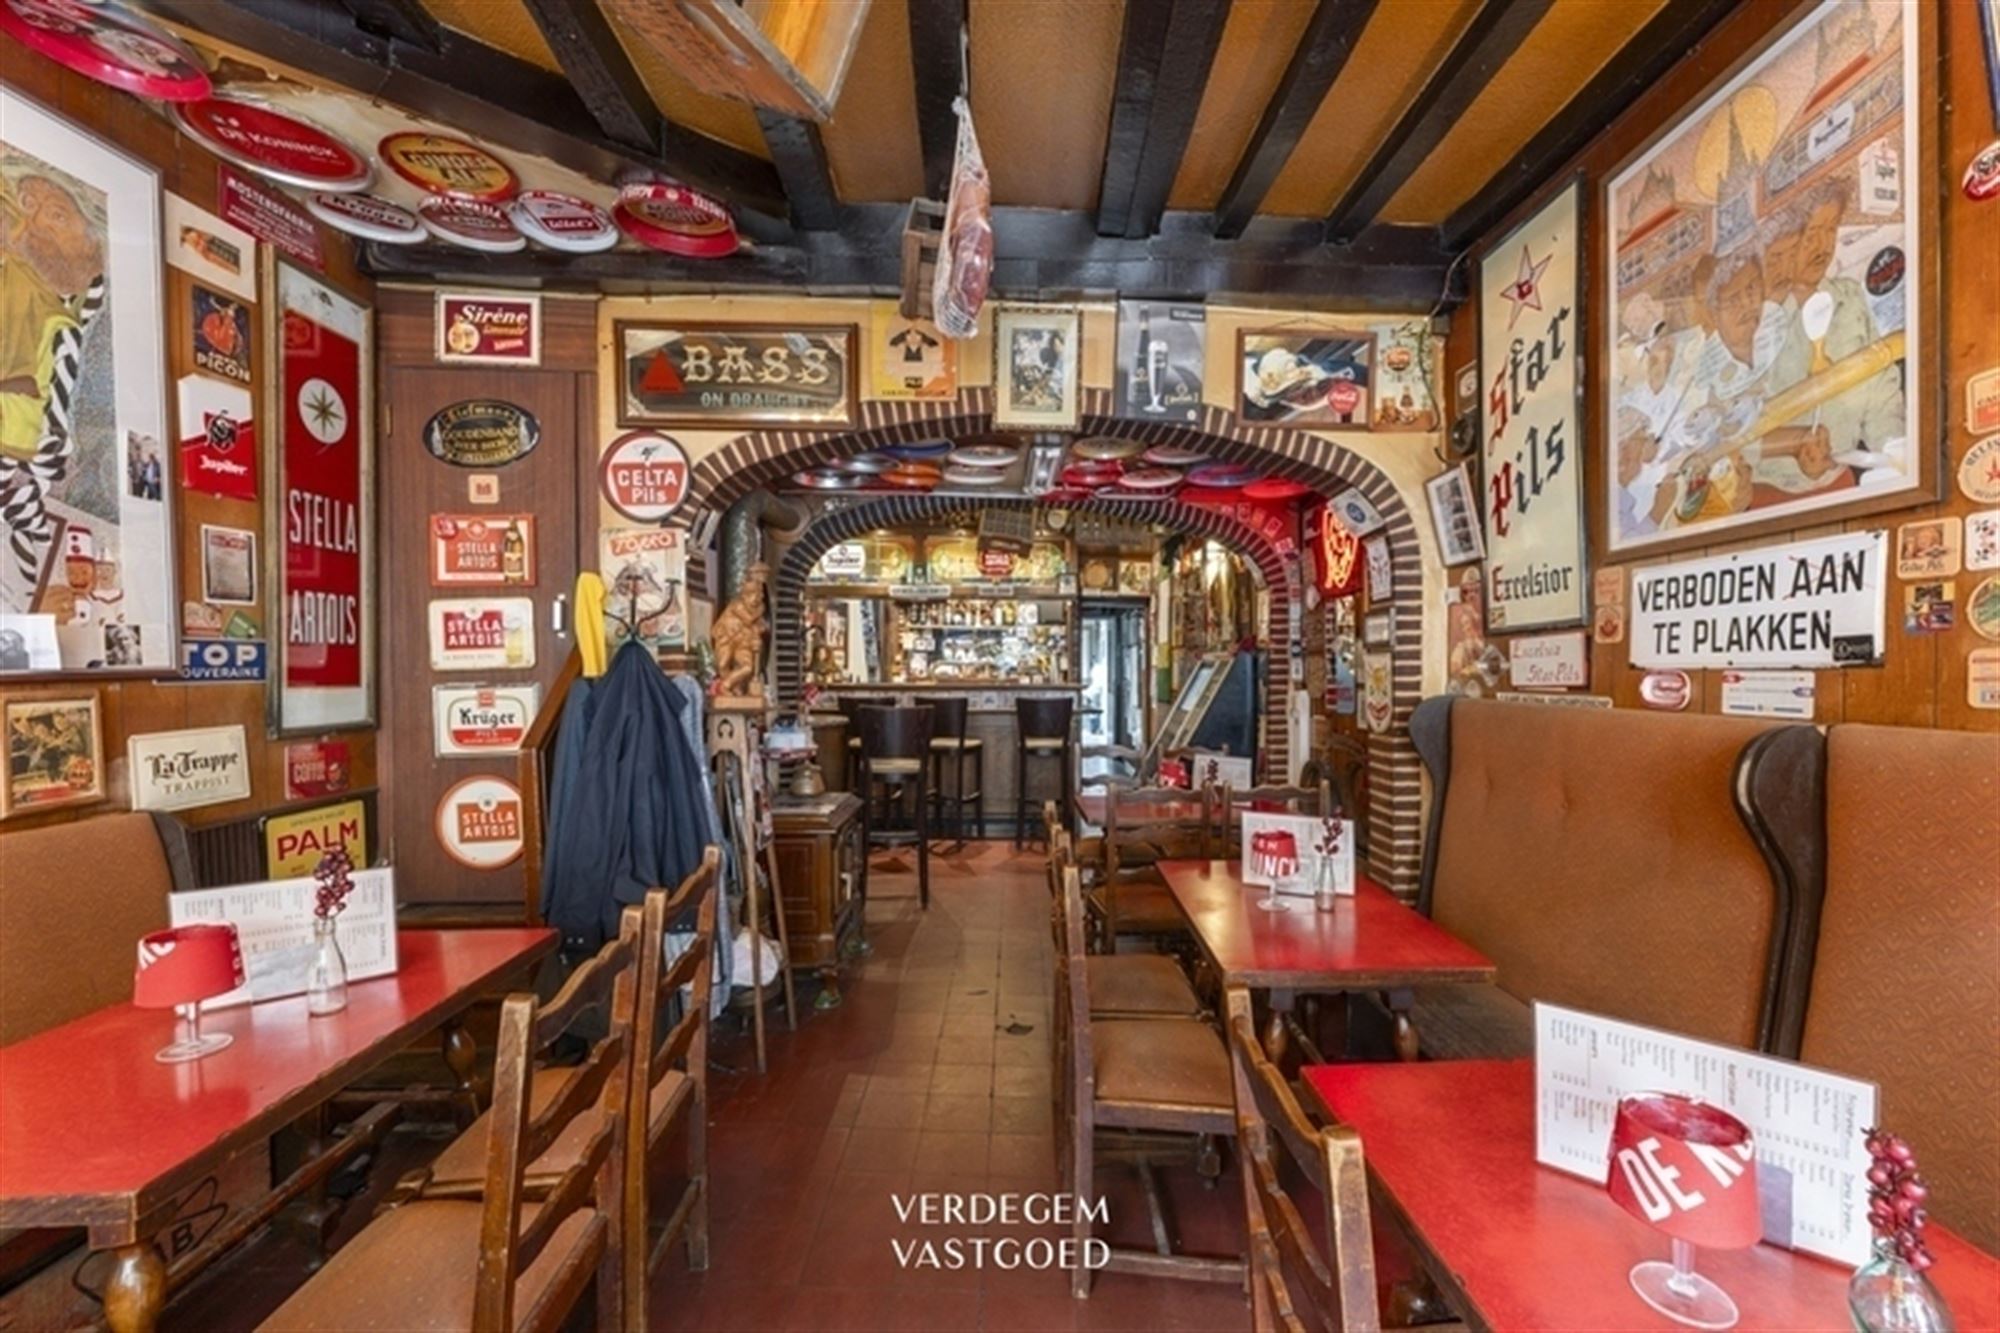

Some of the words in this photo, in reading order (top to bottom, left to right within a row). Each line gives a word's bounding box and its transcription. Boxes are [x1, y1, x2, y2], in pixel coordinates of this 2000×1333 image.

[461, 304, 529, 324] Sirène
[197, 352, 250, 382] PICON
[681, 345, 830, 384] BASS
[1489, 306, 1571, 456] Star
[701, 392, 724, 407] ON
[730, 392, 809, 408] DRAUGHT
[618, 469, 678, 487] CELTA
[1491, 415, 1567, 537] Pils
[632, 487, 667, 504] Pils
[289, 488, 357, 554] STELLA
[457, 542, 496, 554] STELLA
[457, 555, 498, 568] ARTOIS
[1492, 562, 1573, 603] Excelsior
[1638, 562, 1776, 613] VERBODEN
[1791, 550, 1865, 598] AAN
[289, 590, 357, 646] ARTOIS
[447, 619, 502, 633] STELLA
[448, 634, 502, 647] ARTOIS
[1653, 622, 1681, 654] TE
[1693, 610, 1831, 653] PLAKKEN
[459, 708, 516, 729] Krüger
[144, 753, 175, 781] La
[175, 750, 240, 776] Trappe
[164, 774, 233, 795] TRAPPIST
[461, 811, 516, 826] STELLA
[277, 817, 358, 862] PALM
[463, 825, 517, 839] ARTOIS
[1618, 1137, 1705, 1222] DE
